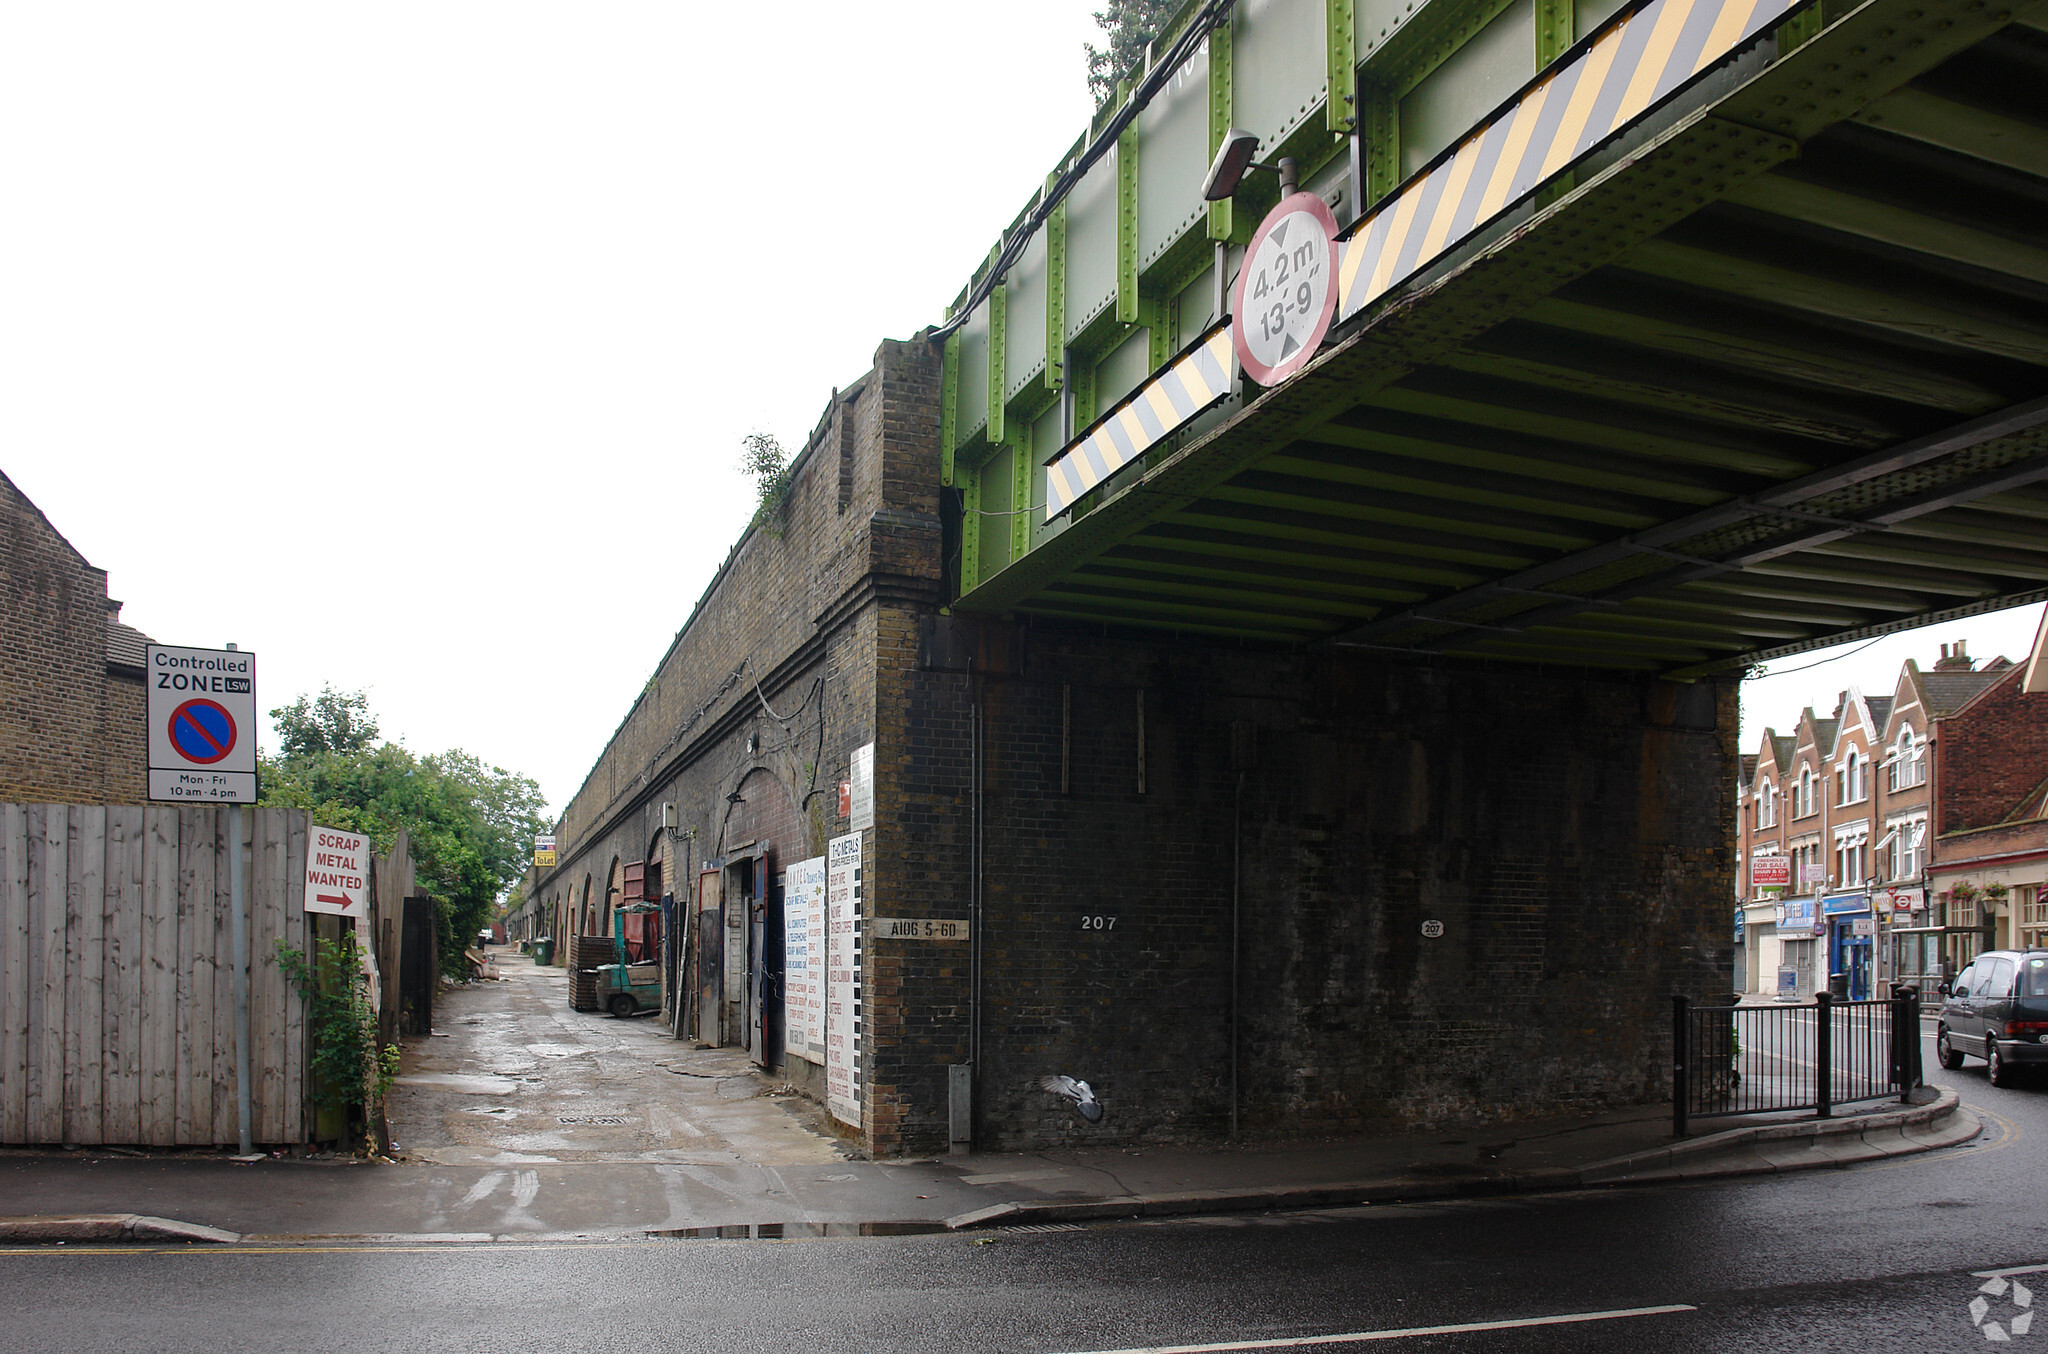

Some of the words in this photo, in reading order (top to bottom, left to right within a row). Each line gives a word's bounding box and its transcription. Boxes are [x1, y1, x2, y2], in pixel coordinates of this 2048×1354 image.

[155, 653, 248, 673] Controlled
[157, 672, 223, 693] ZONE
[226, 680, 249, 692] LSW
[179, 774, 203, 785] Mon
[212, 775, 227, 785] Fri
[169, 787, 183, 797] 10
[185, 789, 202, 797] am
[210, 787, 217, 797] 4
[220, 790, 237, 800] pm
[317, 833, 361, 852] SCRAP
[841, 838, 858, 855] METALS
[315, 852, 358, 871] METAL
[308, 870, 362, 890] WANTED
[1081, 916, 1117, 930] 207
[1425, 924, 1440, 933] 207
